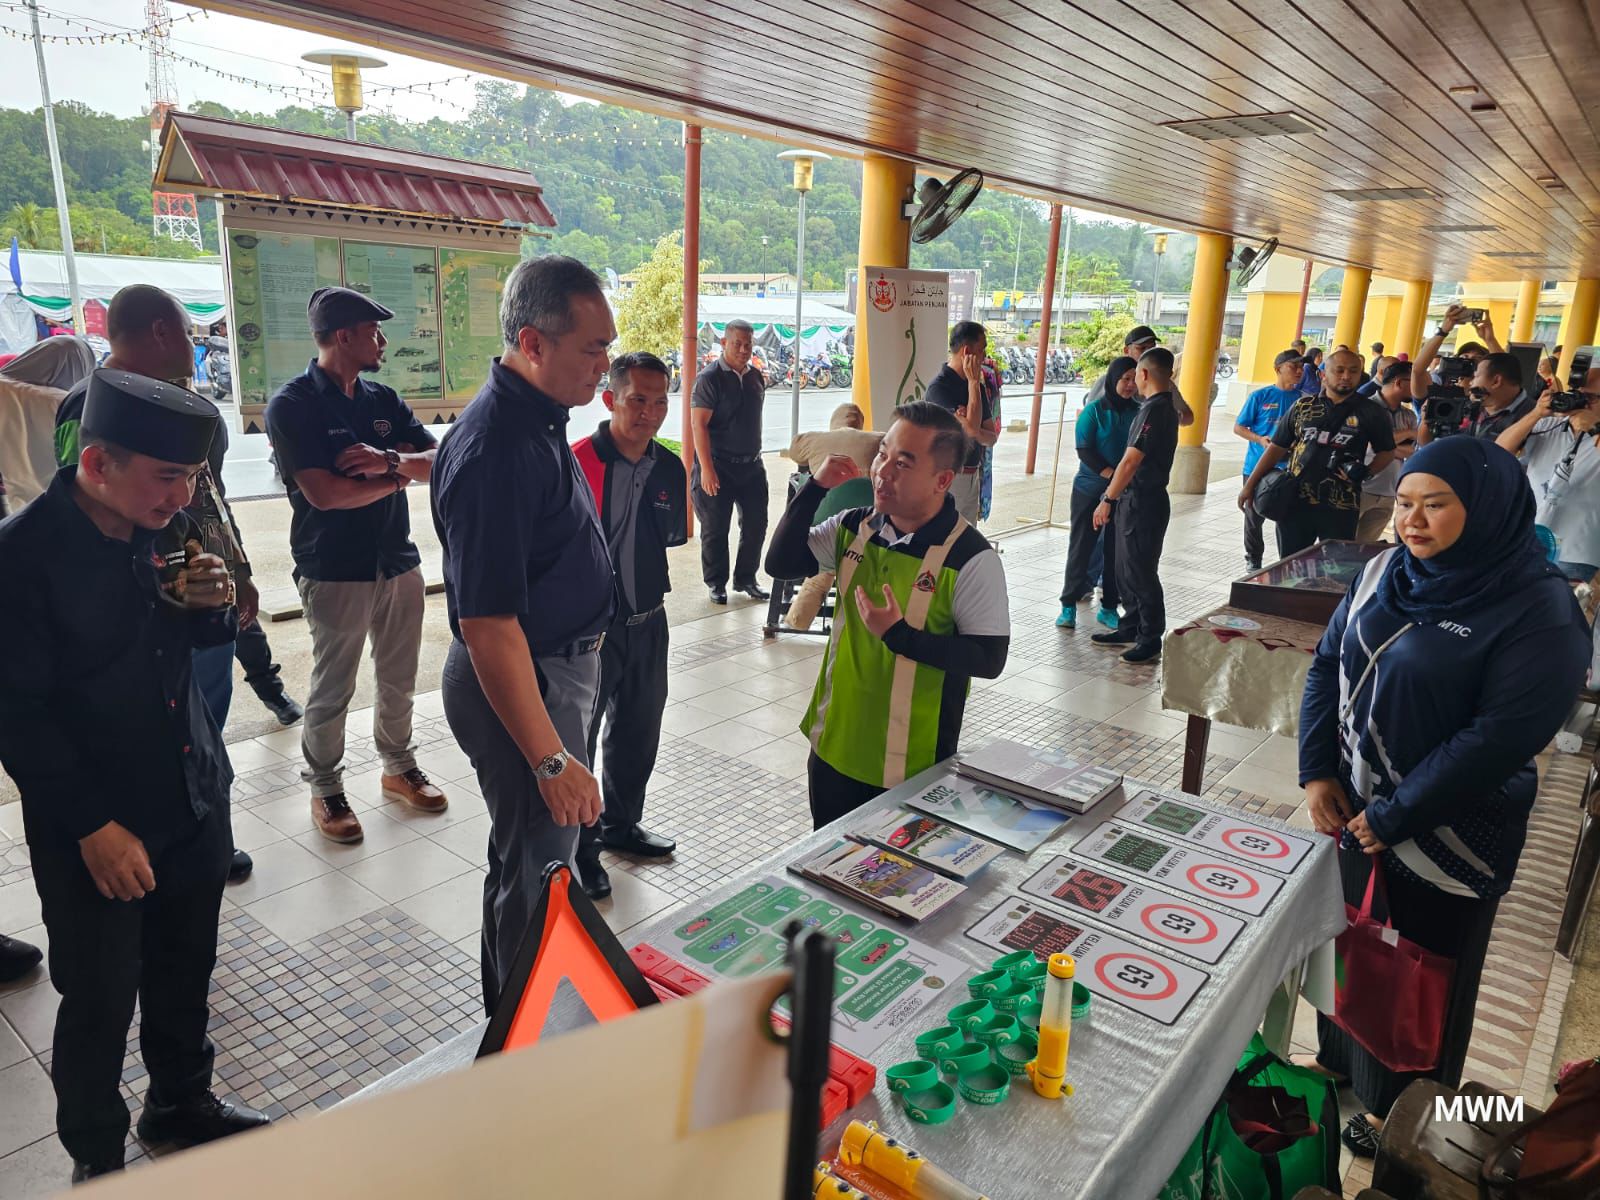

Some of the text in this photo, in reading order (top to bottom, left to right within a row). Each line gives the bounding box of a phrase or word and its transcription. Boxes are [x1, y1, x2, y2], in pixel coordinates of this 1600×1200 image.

[900, 300, 924, 308] JABATAN
[842, 549, 864, 564] MTIC
[1437, 619, 1472, 638] MTIC
[921, 785, 949, 804] 2030
[1238, 834, 1272, 852] 65
[1161, 848, 1189, 869] KELAJUAN
[1051, 868, 1127, 913] 92
[1204, 870, 1240, 891] 65
[1103, 885, 1145, 921] KELAJUAN AWDA
[1002, 912, 1053, 948] LAJU
[1158, 911, 1198, 935] 65
[1067, 931, 1102, 959] KELAJUAN
[1113, 961, 1156, 989] 65
[844, 1168, 895, 1200] FLASHLIGH
